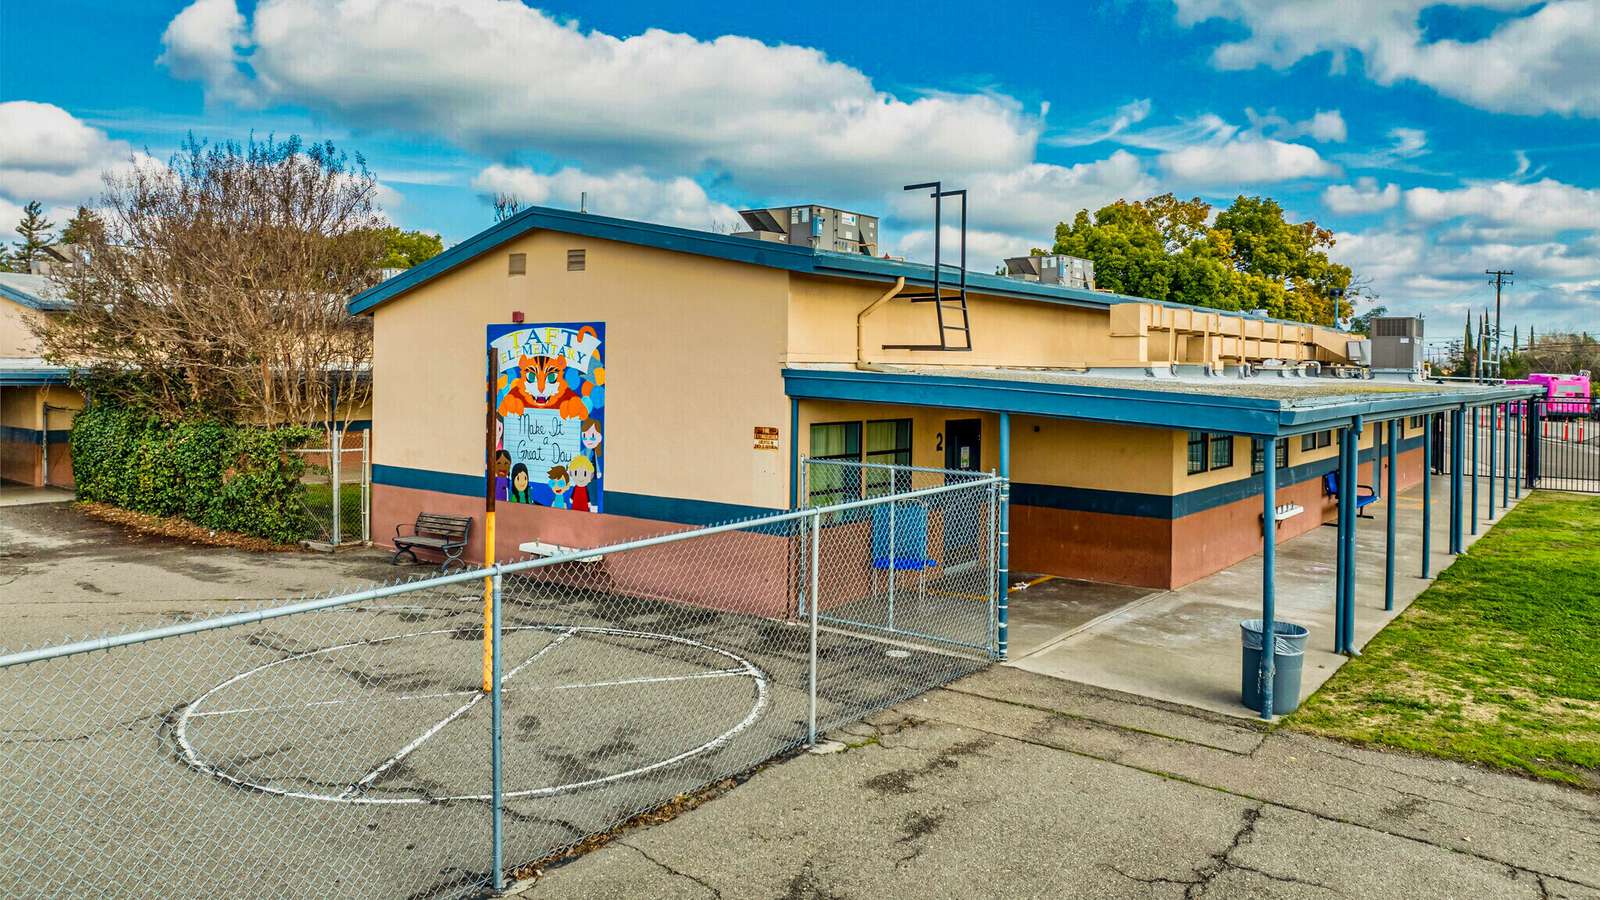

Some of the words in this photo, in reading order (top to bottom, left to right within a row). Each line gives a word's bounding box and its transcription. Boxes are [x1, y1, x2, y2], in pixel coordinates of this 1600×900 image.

[508, 327, 578, 348] TAFT
[501, 343, 586, 365] ELEMENTARY
[518, 414, 545, 441] Make
[549, 417, 565, 437] It
[517, 440, 545, 462] Great
[543, 436, 550, 445] a
[936, 431, 943, 451] 2
